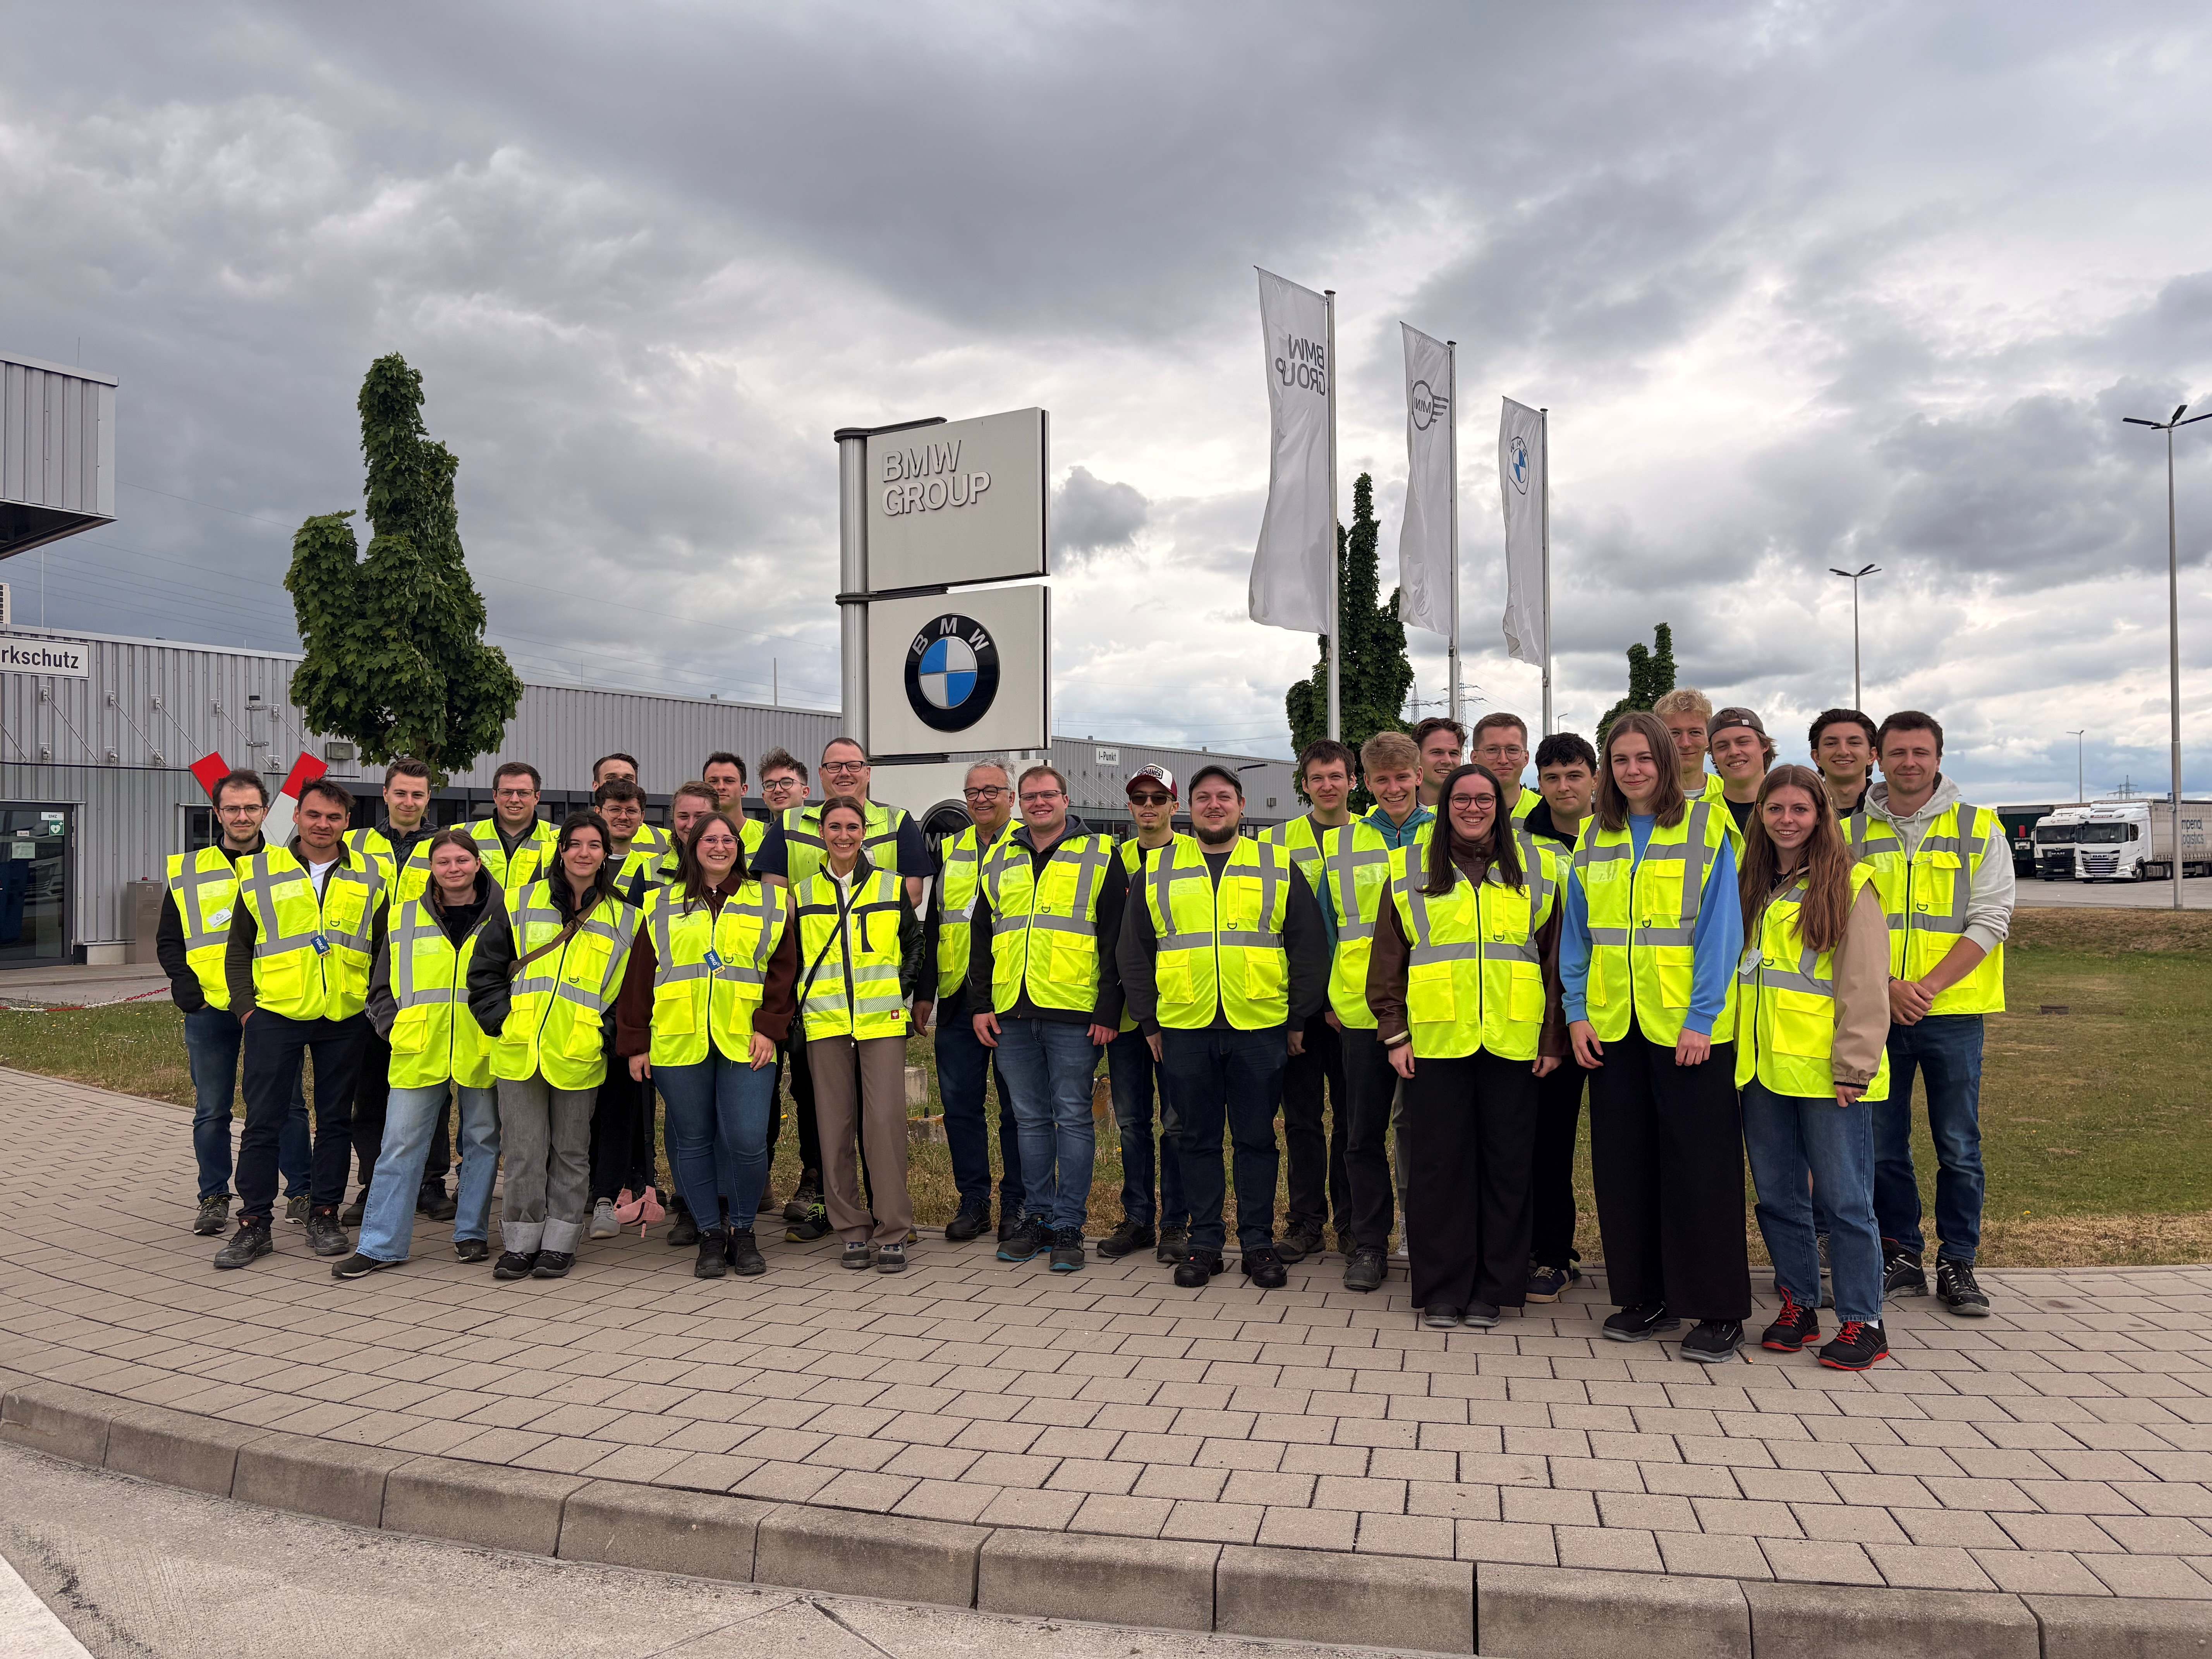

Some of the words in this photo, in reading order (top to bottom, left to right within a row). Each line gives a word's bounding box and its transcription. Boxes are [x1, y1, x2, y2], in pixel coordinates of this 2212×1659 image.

[883, 439, 961, 483] BMW
[882, 471, 991, 515] GROUP
[912, 617, 989, 656] BMW
[2, 645, 79, 669] rkschutz
[1099, 751, 1116, 761] I-Punkt
[2181, 817, 2203, 833] mperial
[315, 937, 325, 950] YOKO
[708, 952, 717, 965] YOKO
